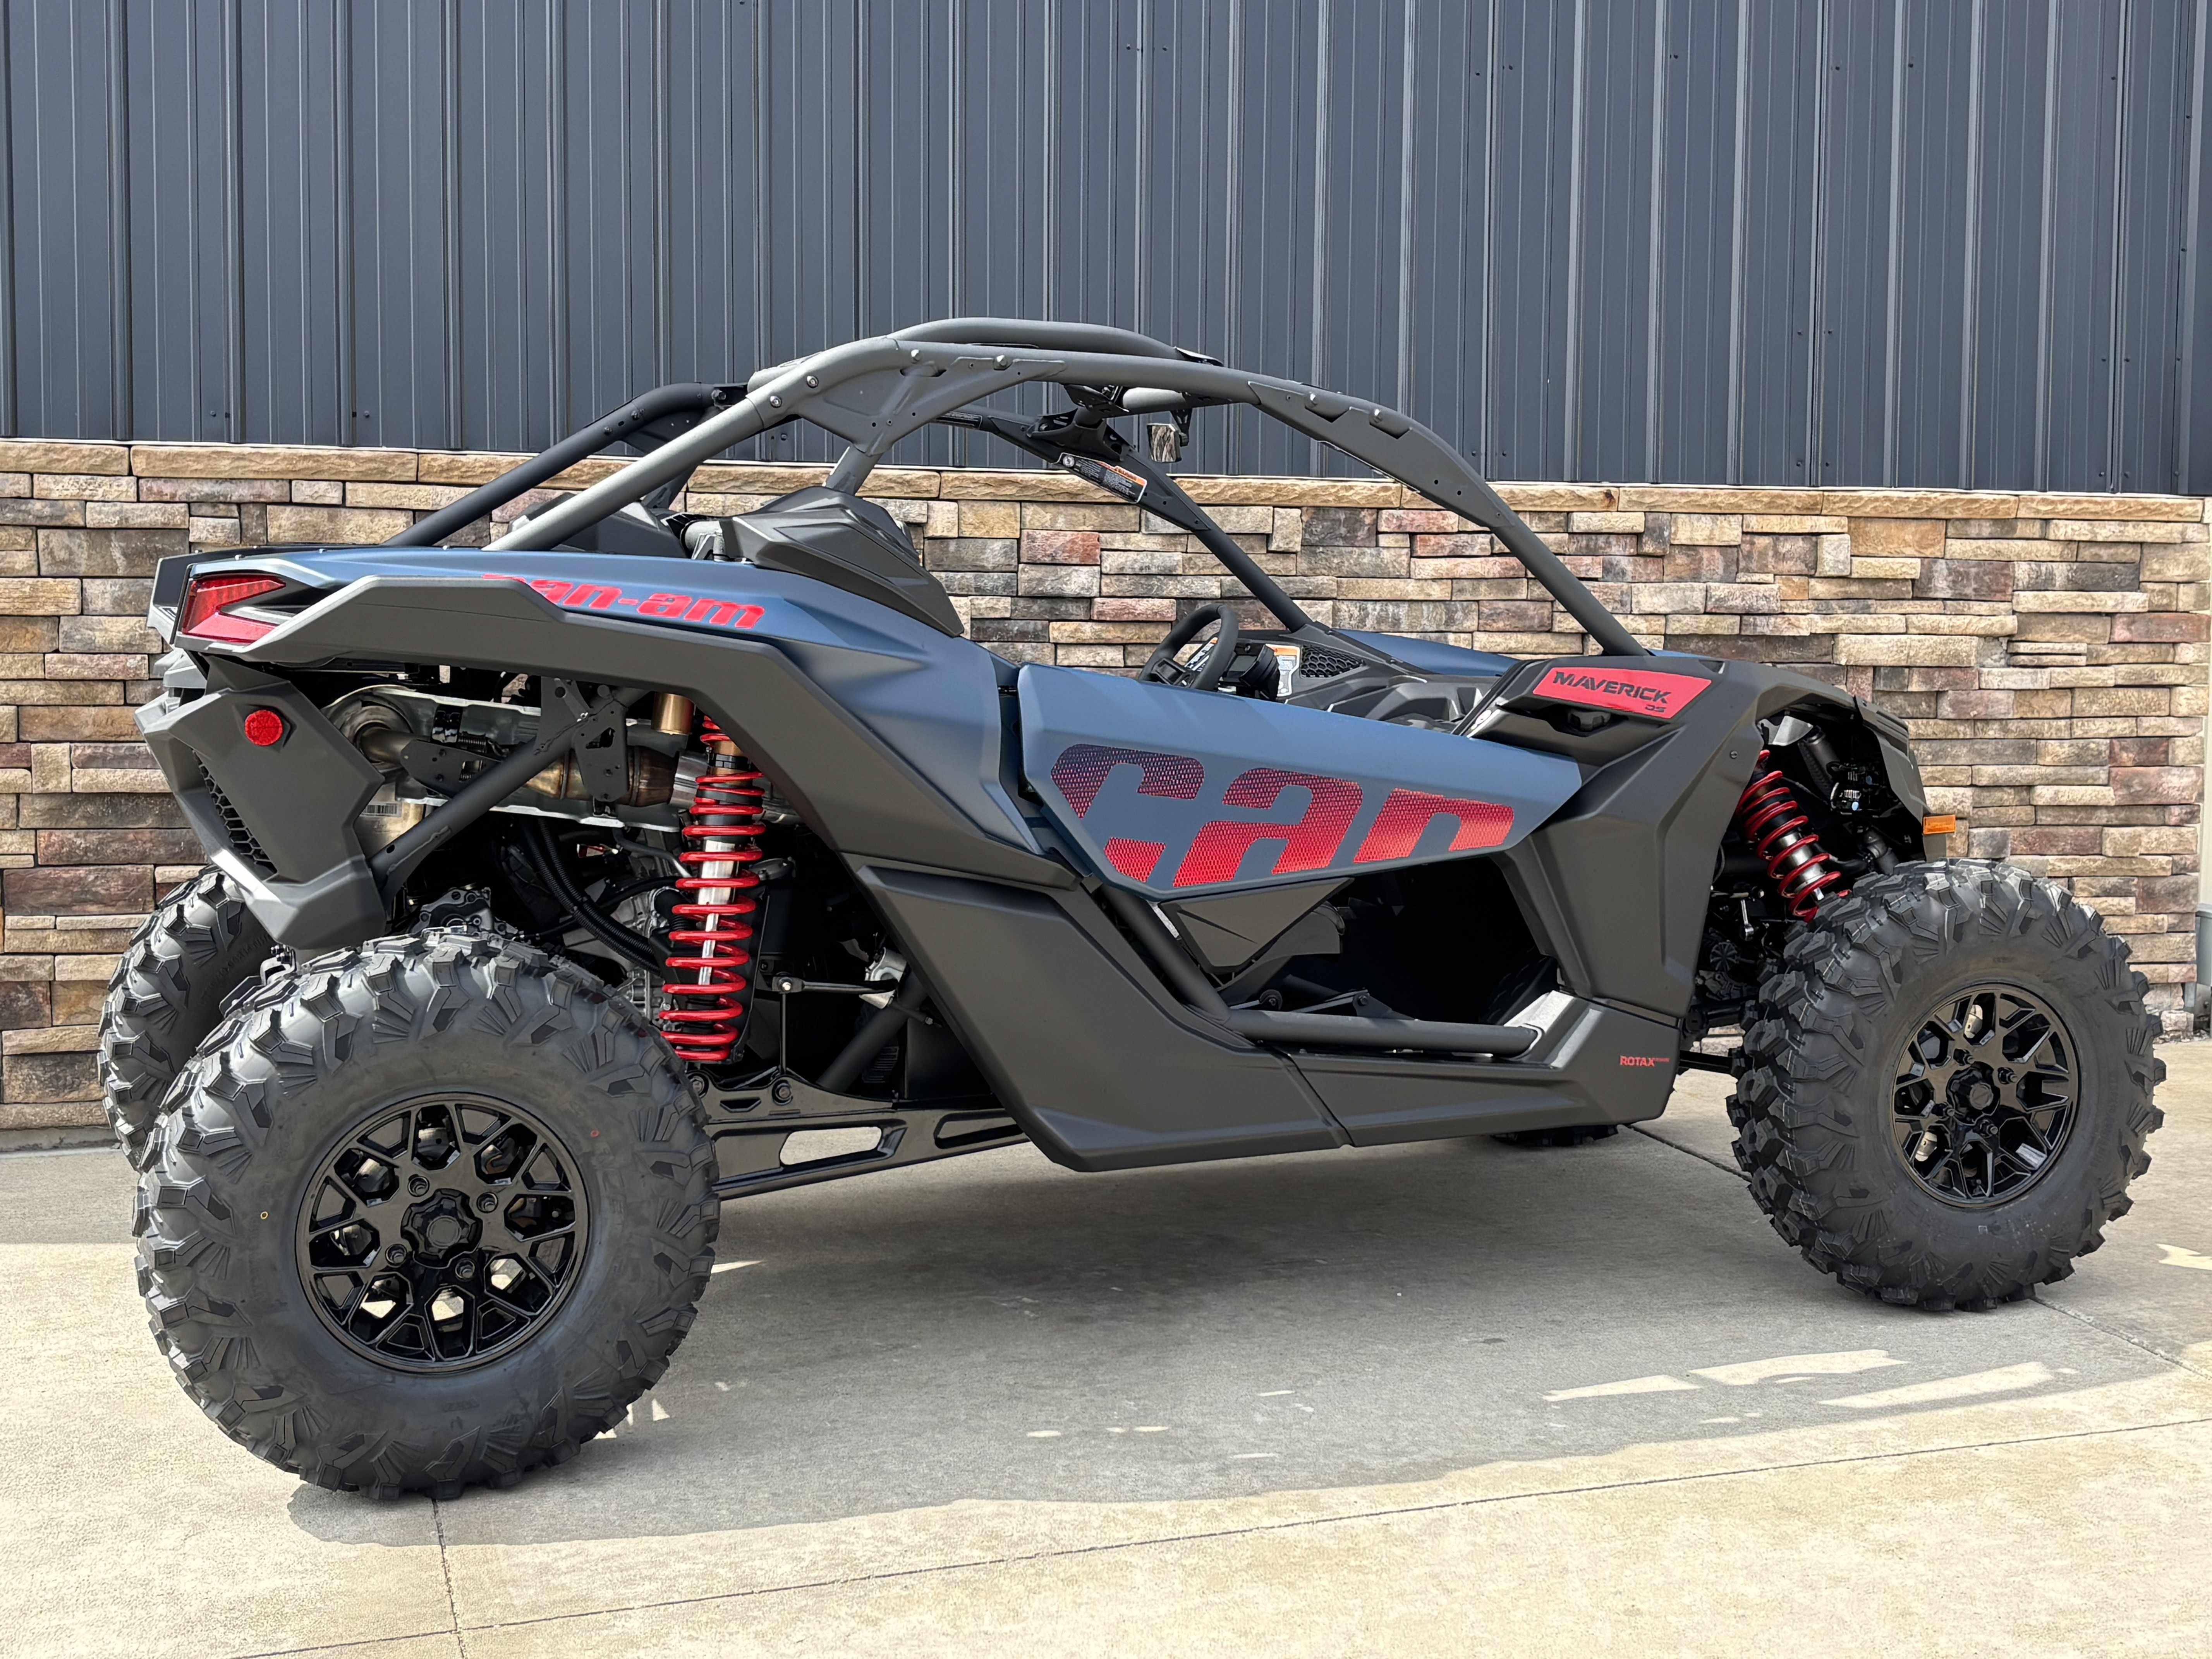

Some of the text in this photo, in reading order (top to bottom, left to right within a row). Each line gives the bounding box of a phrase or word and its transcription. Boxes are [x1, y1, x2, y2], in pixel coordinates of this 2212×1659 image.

[482, 574, 765, 629] an-am
[1553, 672, 1671, 704] MAVERICK
[1620, 1055, 1655, 1066] ROTAX
